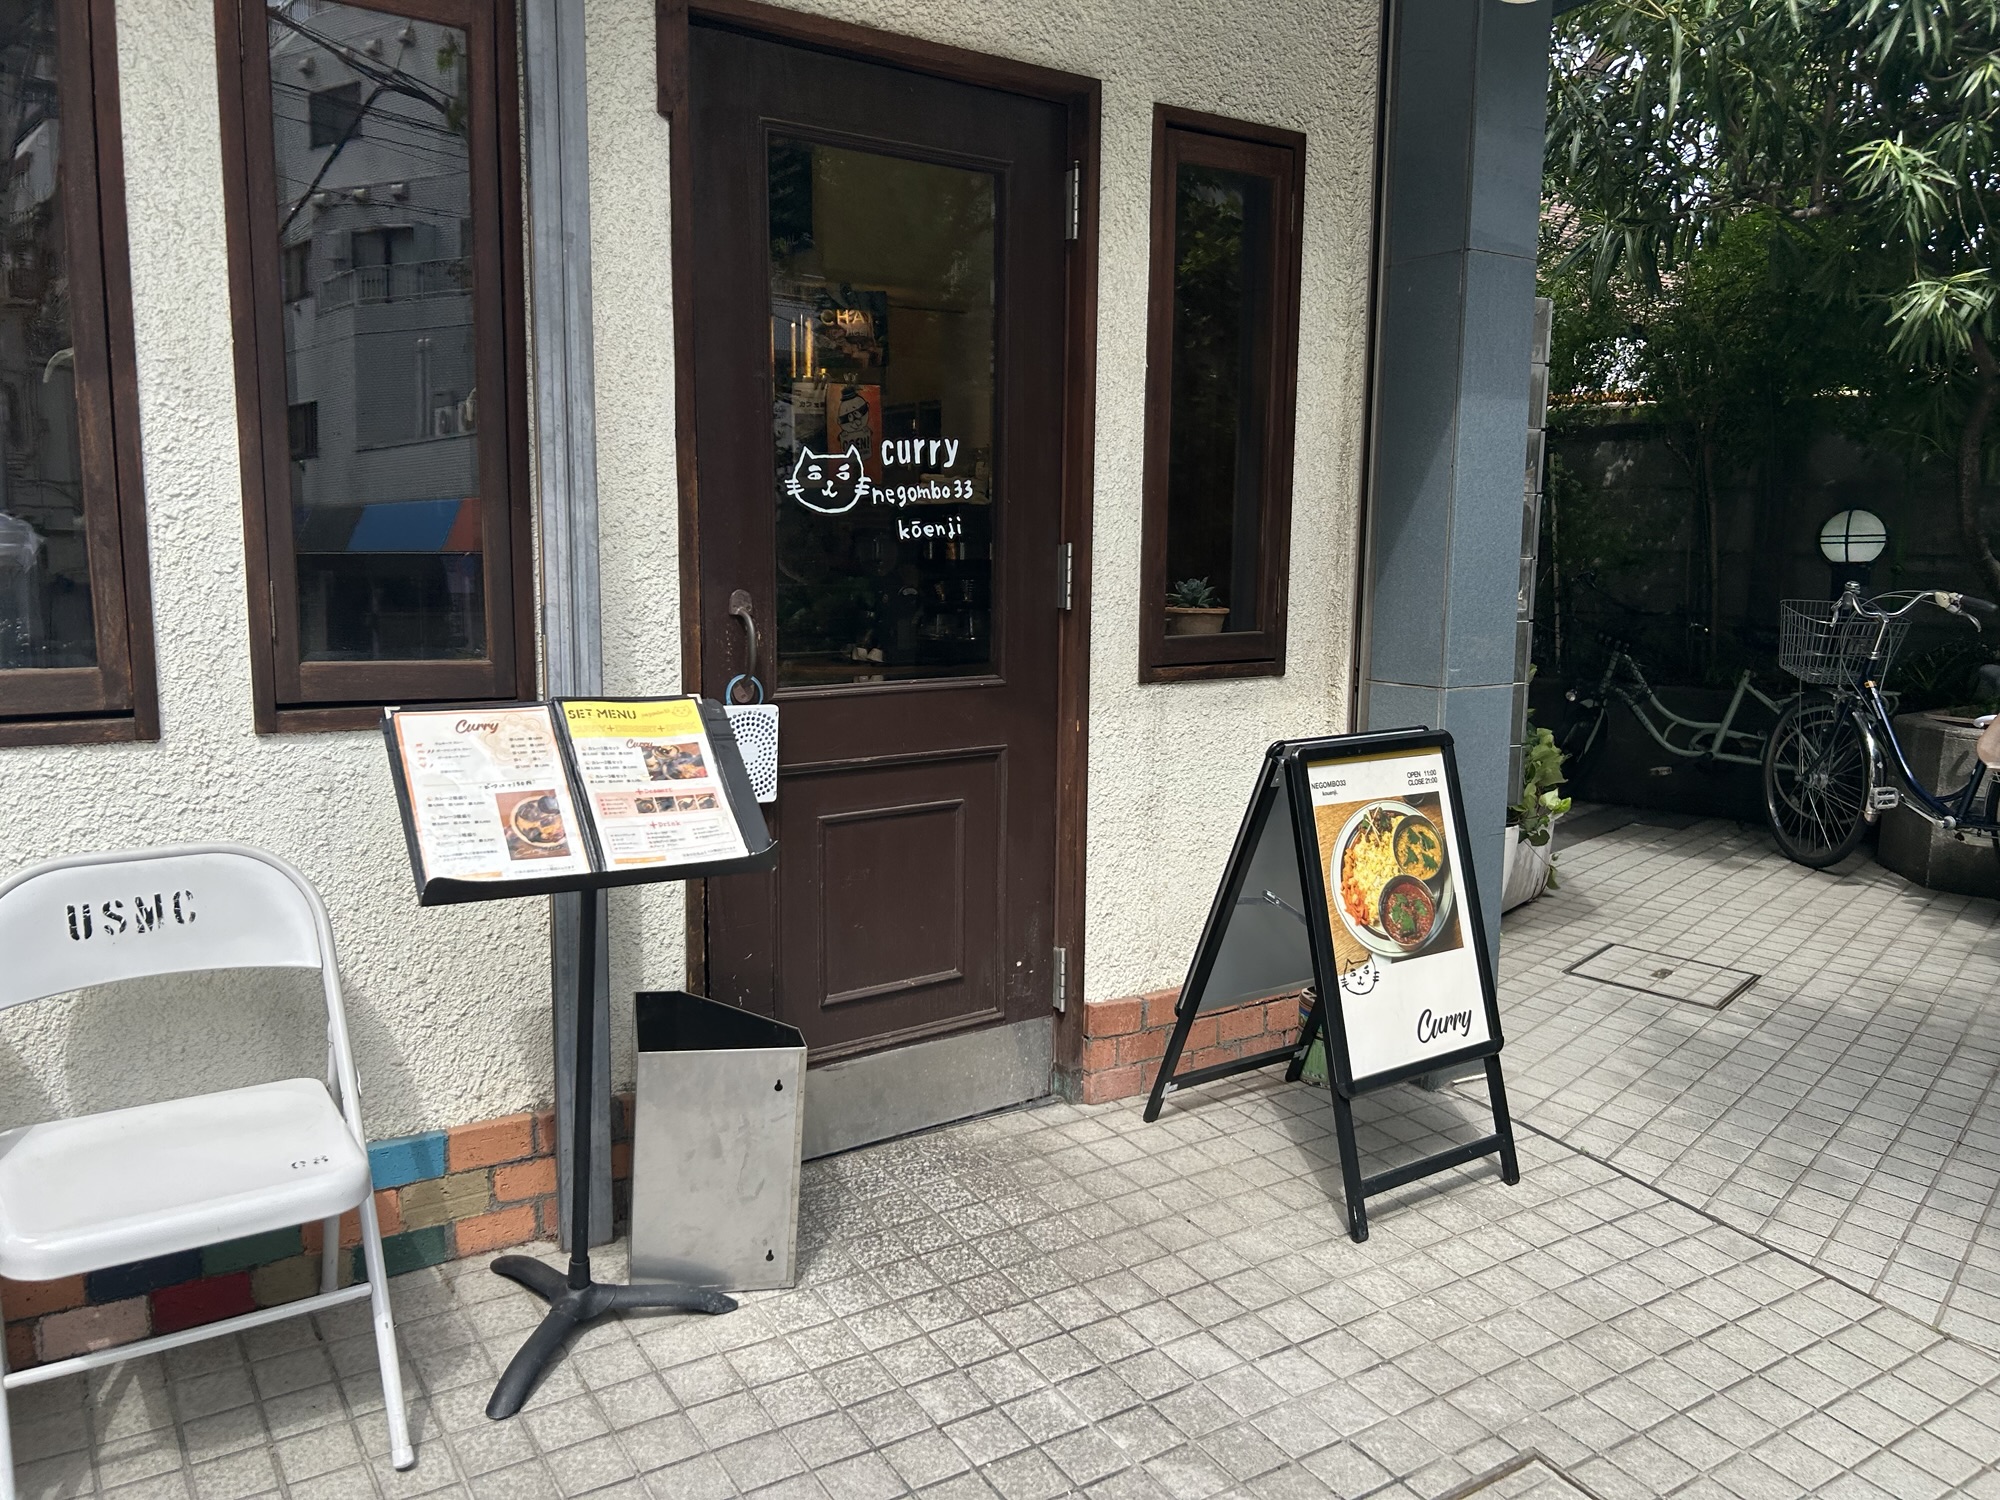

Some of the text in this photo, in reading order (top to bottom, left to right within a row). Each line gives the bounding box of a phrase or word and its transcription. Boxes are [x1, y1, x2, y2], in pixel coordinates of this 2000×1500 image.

[881, 438, 959, 468] curry
[568, 709, 637, 720] SET MENU
[455, 719, 499, 734] Curry
[626, 738, 654, 749] Curry
[1311, 779, 1347, 789] NEGOMBO33
[1408, 776, 1438, 787] CLOSE 21:00
[66, 889, 197, 941] USMC
[1416, 1008, 1473, 1044] Curry
